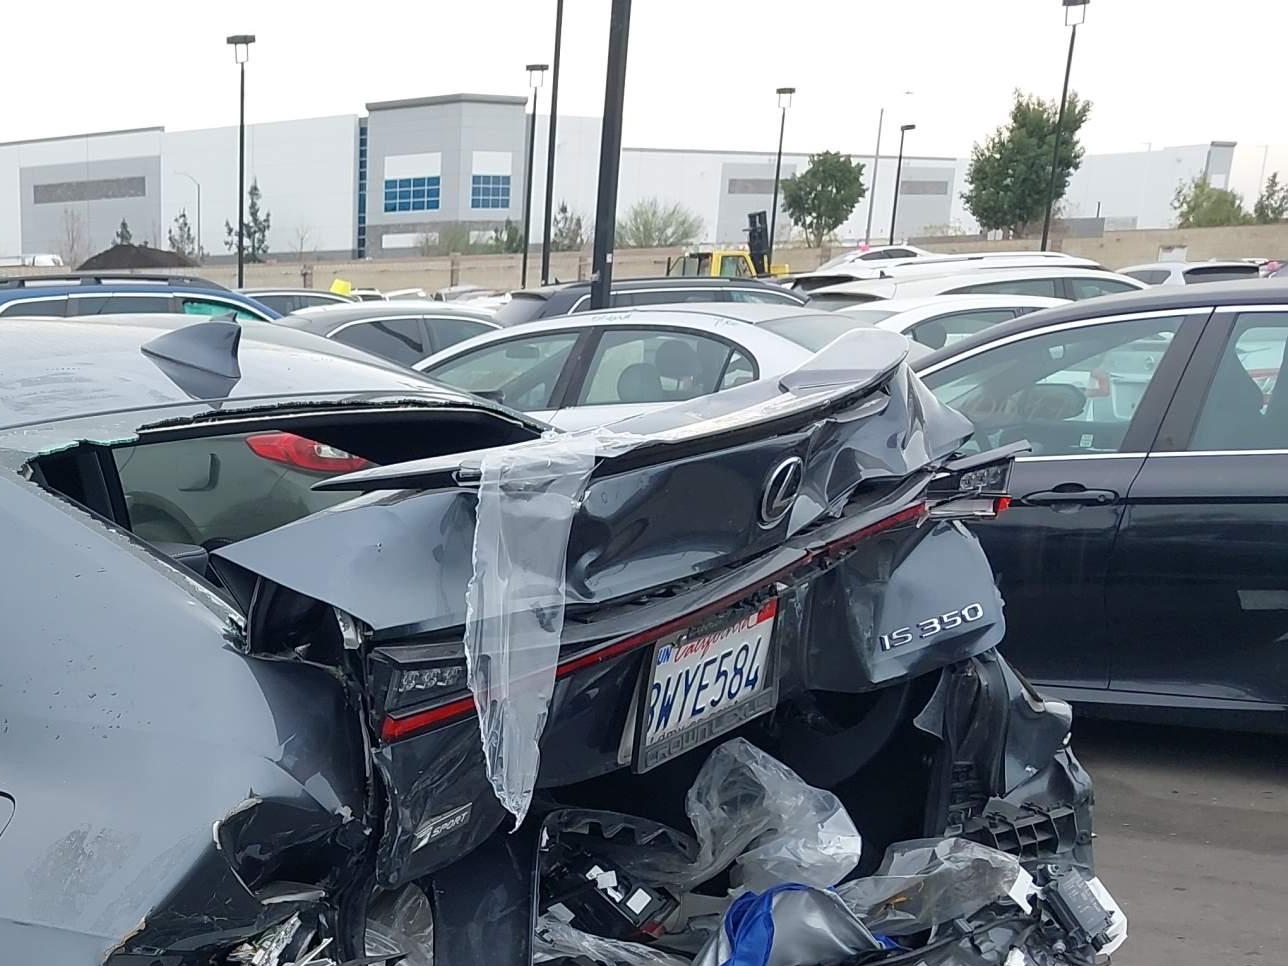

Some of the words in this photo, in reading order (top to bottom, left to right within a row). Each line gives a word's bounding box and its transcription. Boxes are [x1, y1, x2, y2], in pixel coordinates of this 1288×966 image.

[880, 626, 913, 652] IS
[916, 602, 984, 639] 350
[431, 811, 469, 838] SPORT
